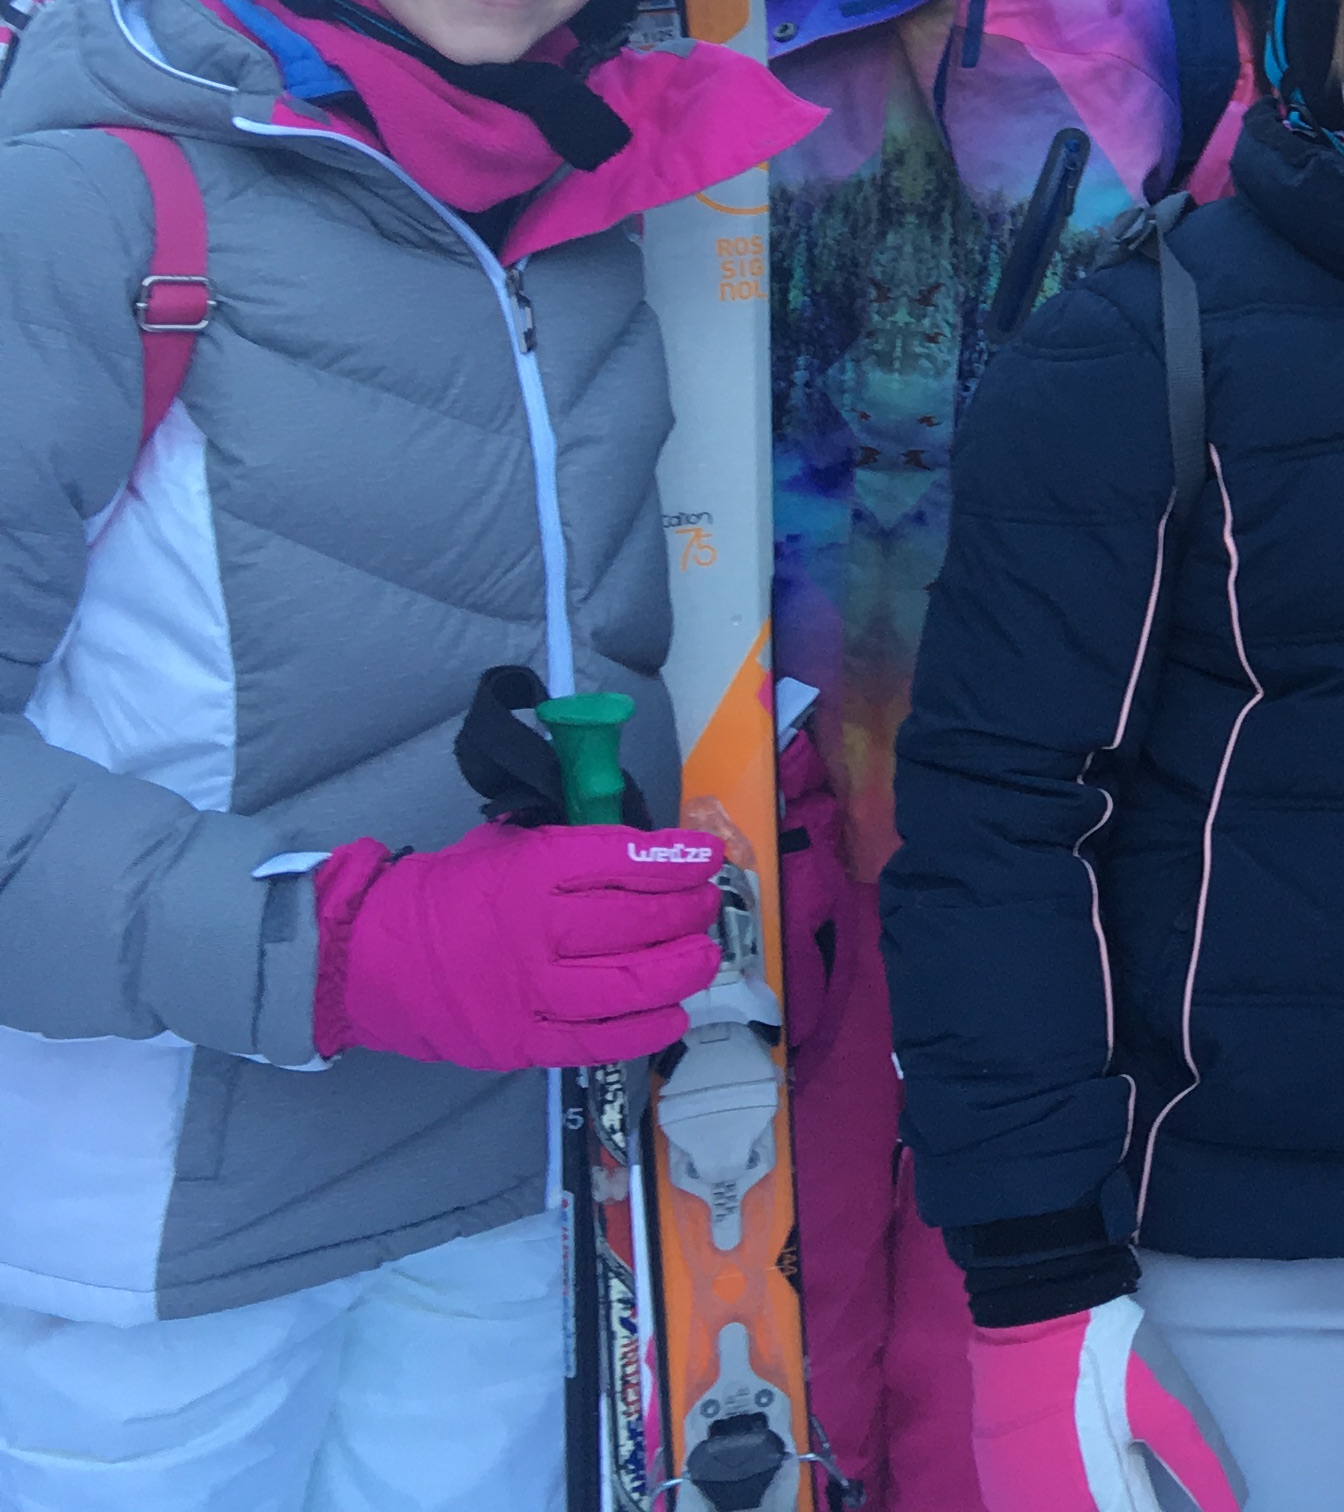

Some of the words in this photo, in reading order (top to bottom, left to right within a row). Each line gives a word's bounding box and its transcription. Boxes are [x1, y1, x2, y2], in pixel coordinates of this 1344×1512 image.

[716, 235, 765, 258] ROS
[721, 257, 765, 280] SIG
[673, 527, 718, 573] 75
